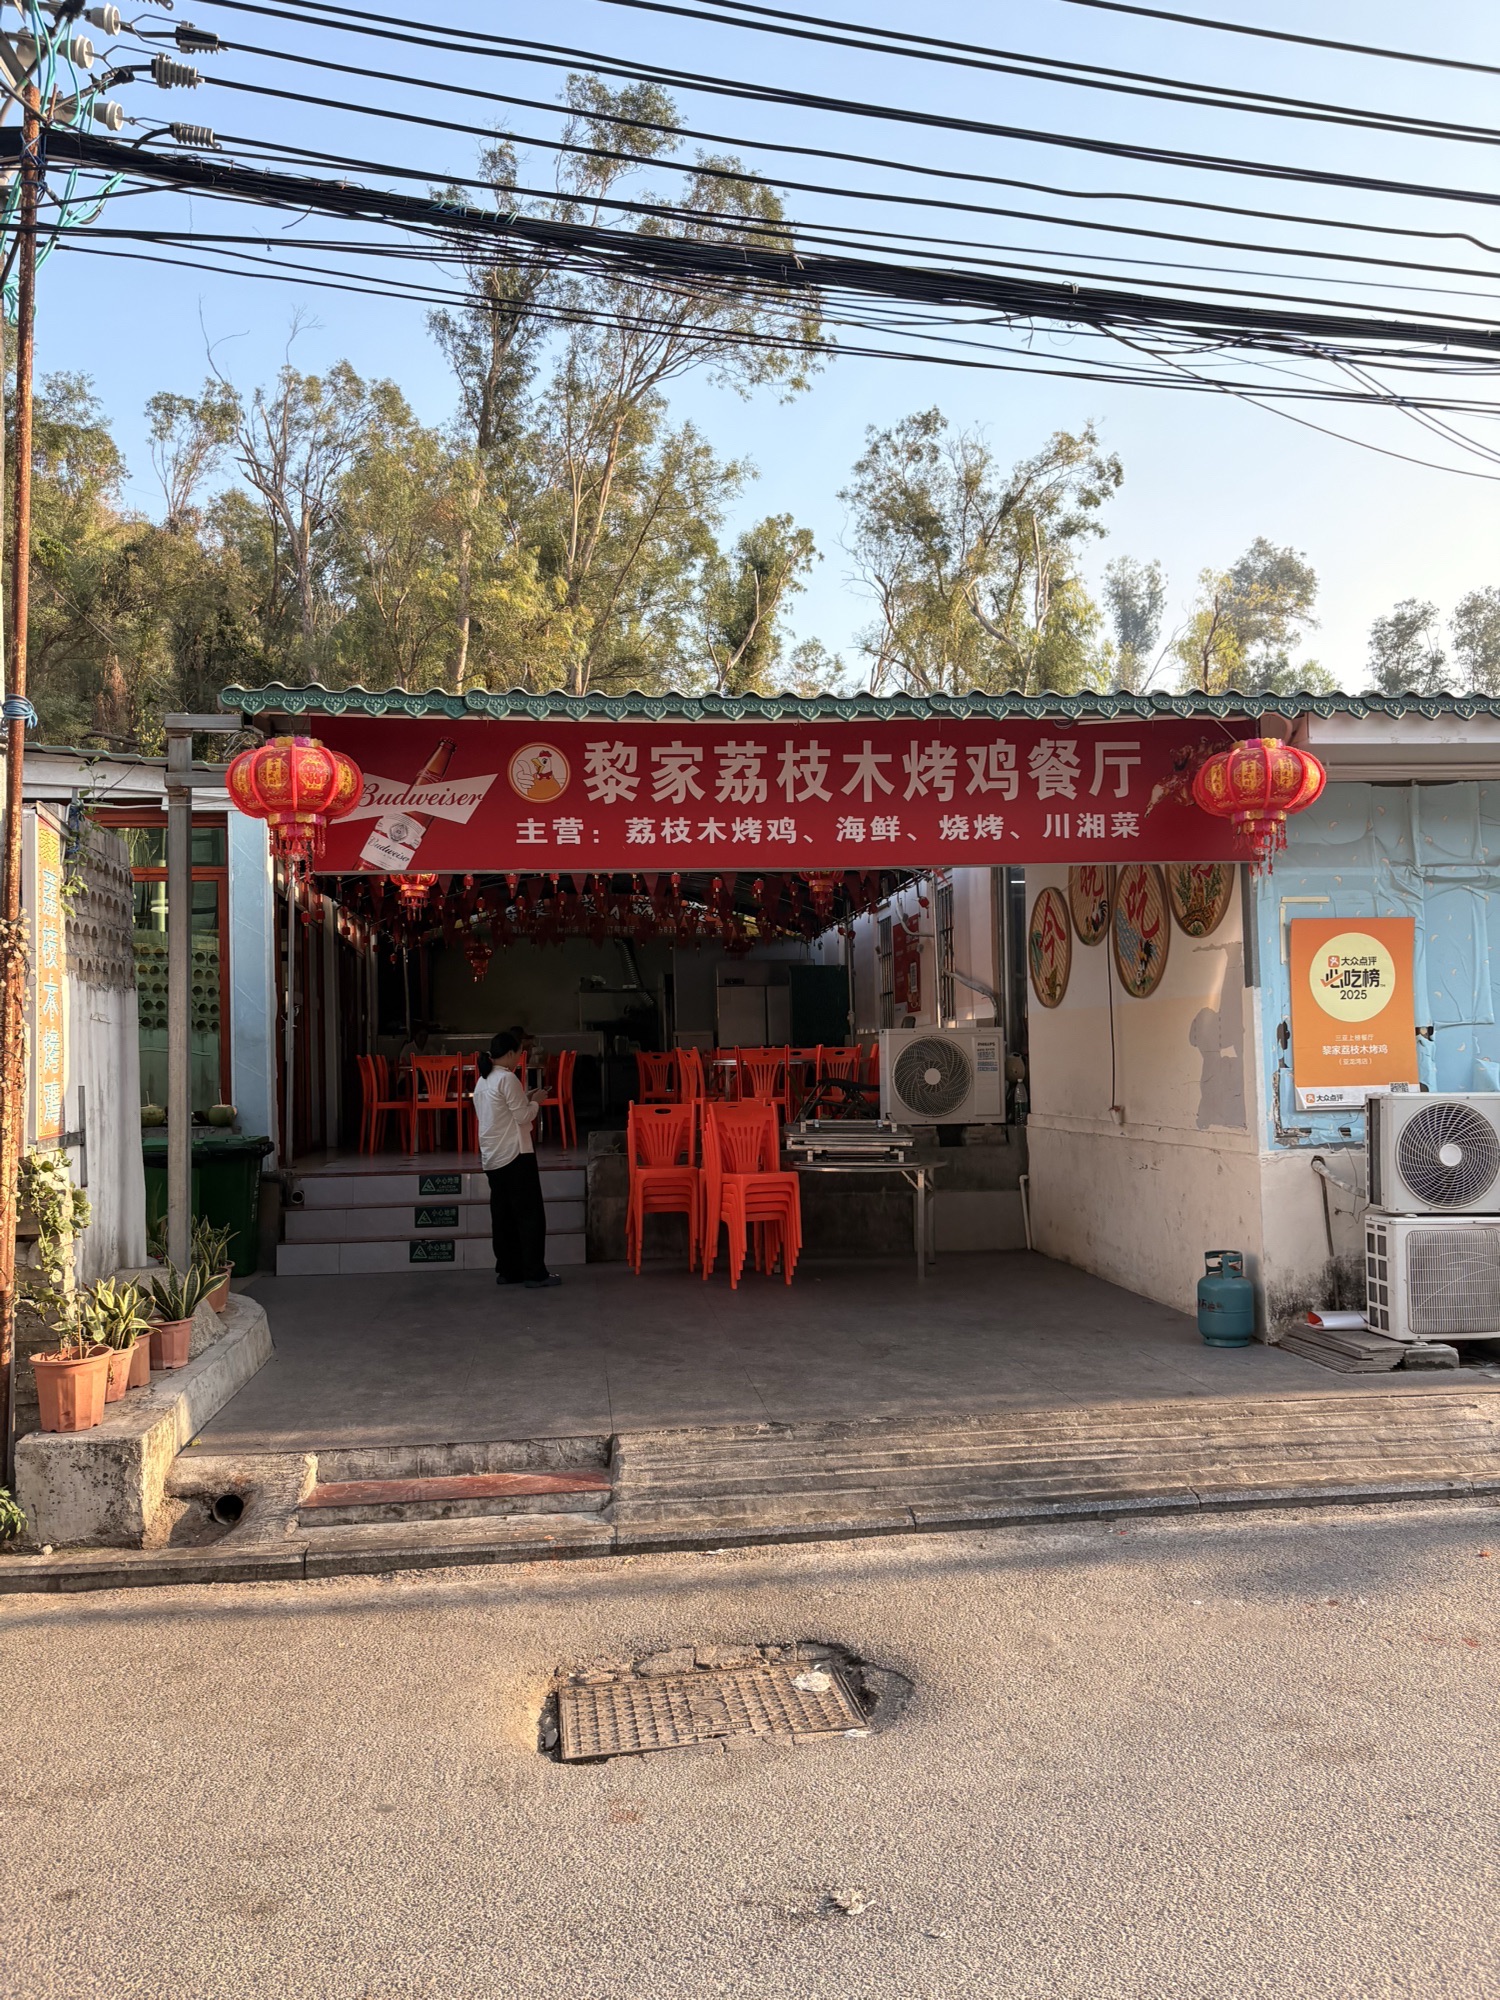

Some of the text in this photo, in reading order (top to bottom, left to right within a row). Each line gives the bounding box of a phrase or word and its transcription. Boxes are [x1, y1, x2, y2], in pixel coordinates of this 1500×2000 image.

[583, 738, 1141, 804] 黎家荔枝木烤鸡餐厅
[358, 782, 484, 808] Budweiser
[367, 835, 410, 863] Budweiser
[1341, 956, 1377, 966] 大众点评
[1340, 989, 1367, 1000] 2025
[1322, 1044, 1388, 1055] 黎家荔枝木烤鸡
[1316, 1094, 1343, 1102] 大众点评
